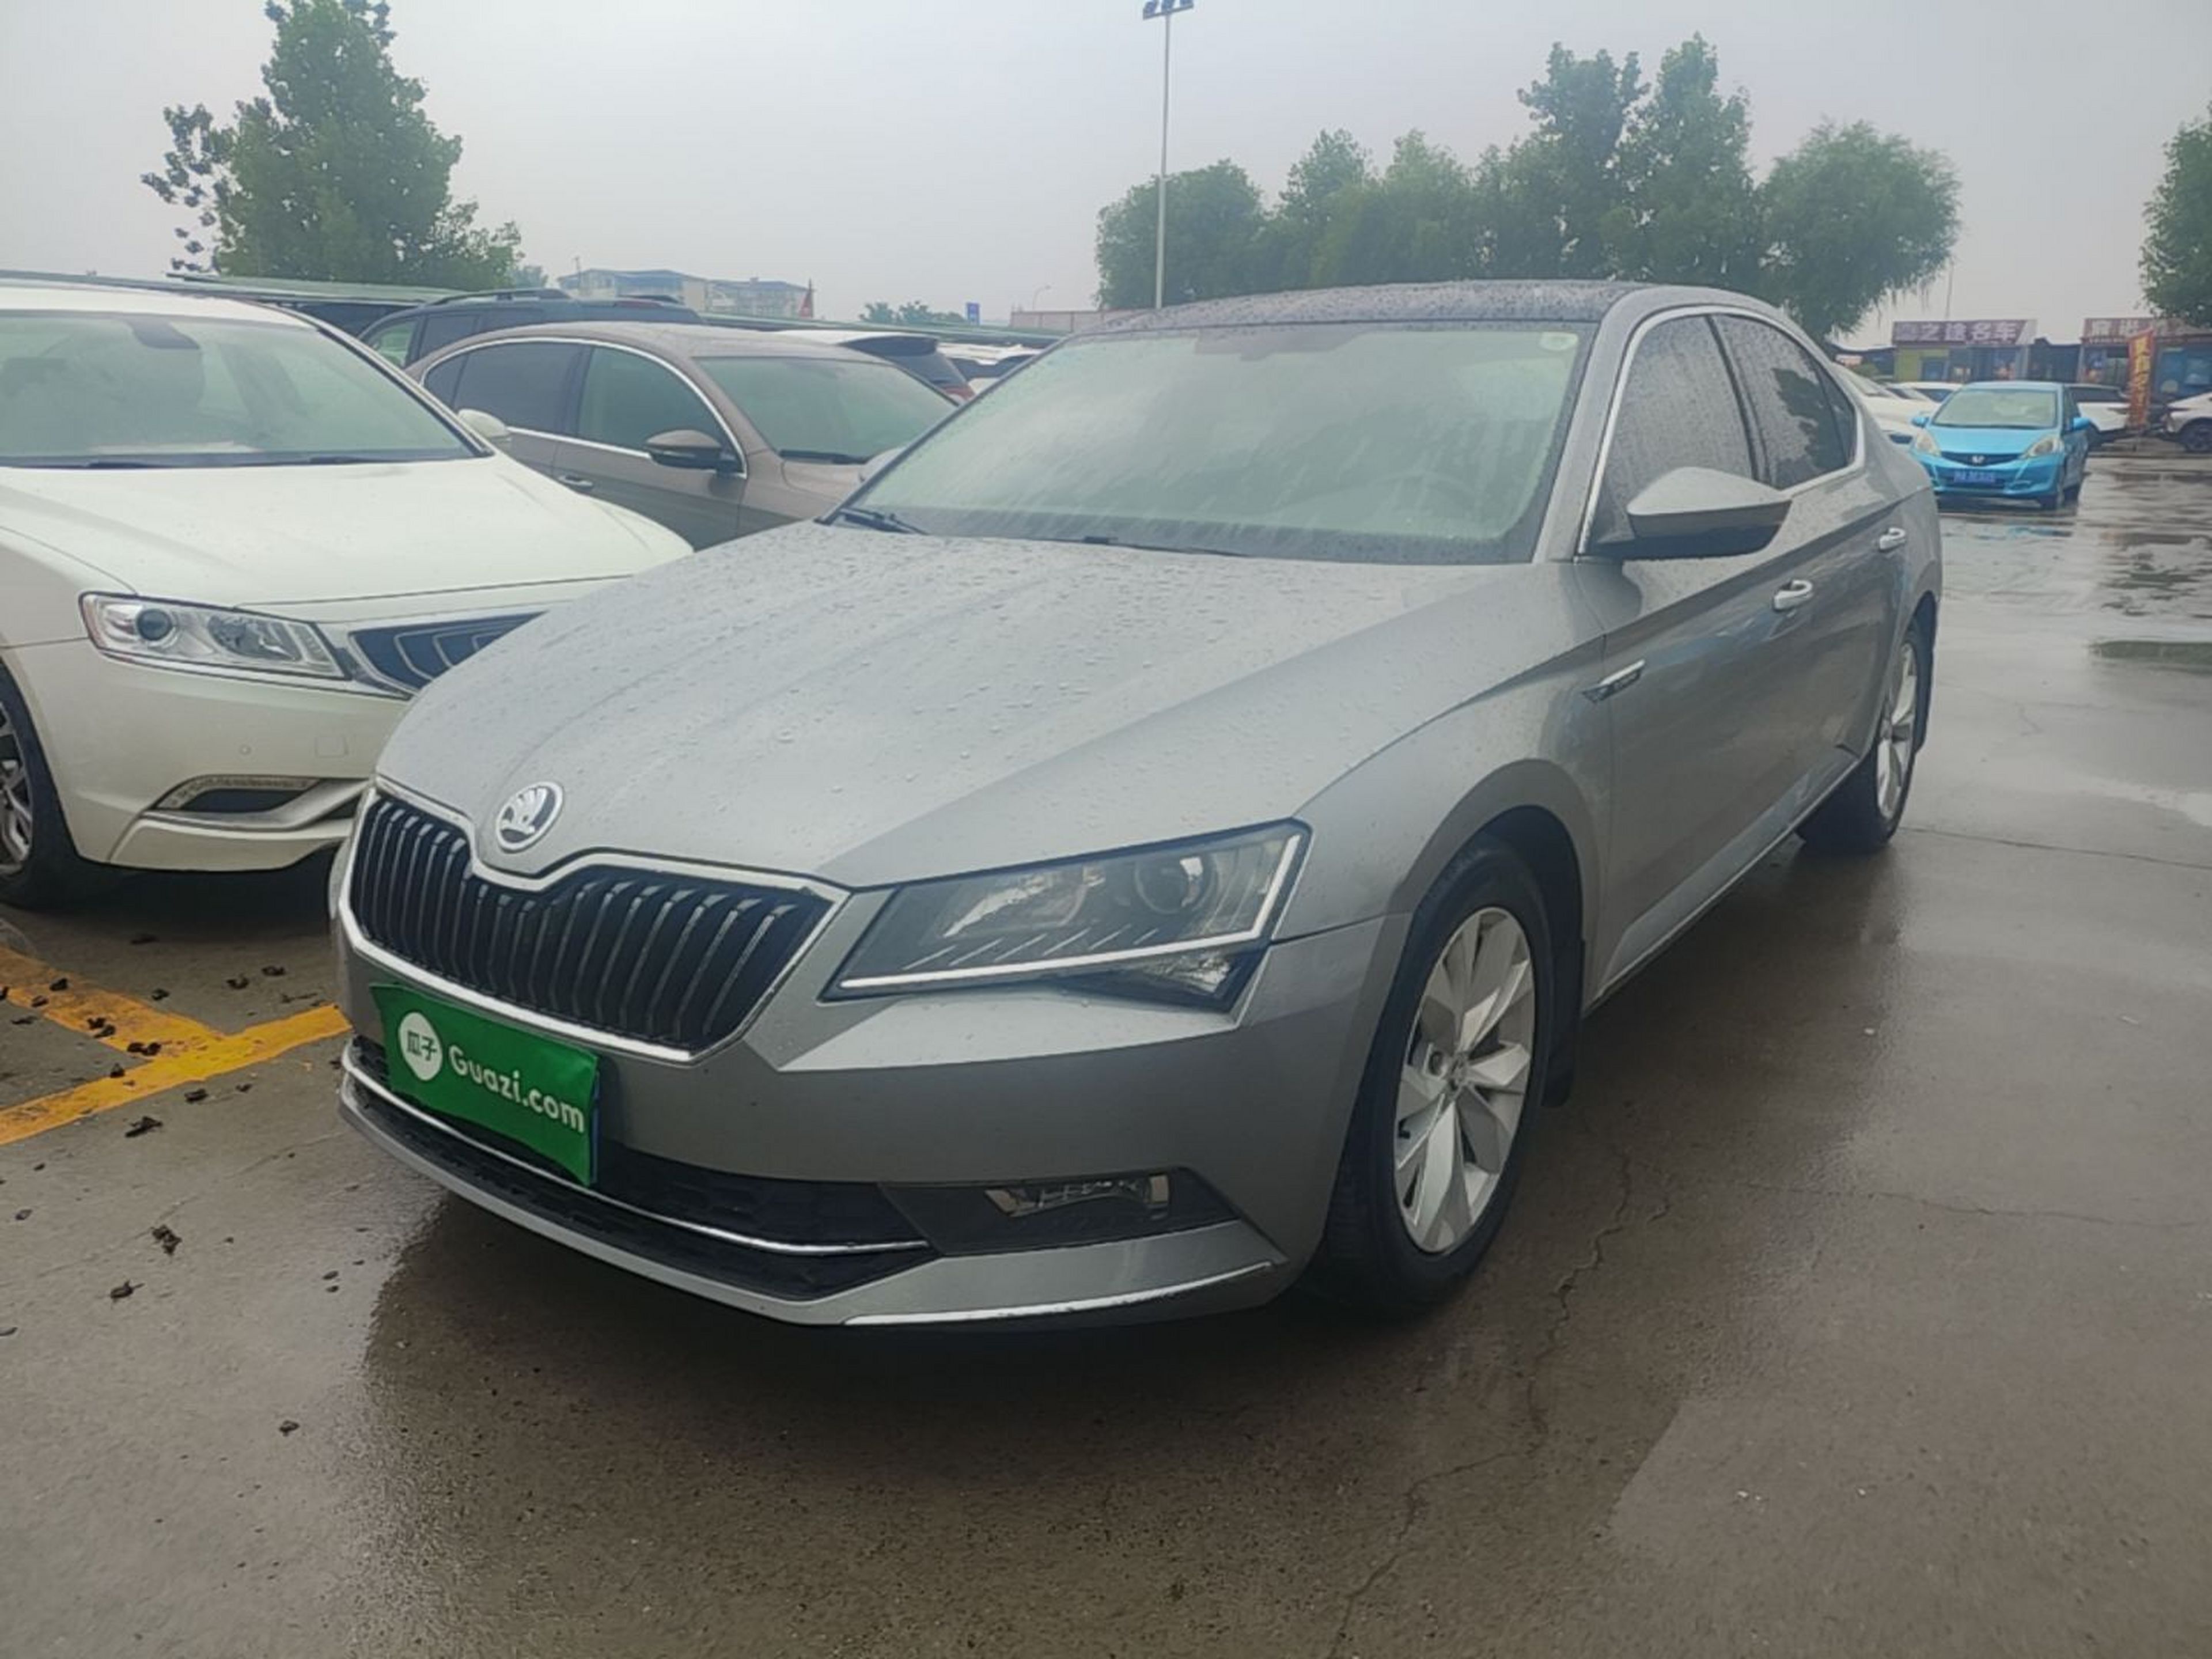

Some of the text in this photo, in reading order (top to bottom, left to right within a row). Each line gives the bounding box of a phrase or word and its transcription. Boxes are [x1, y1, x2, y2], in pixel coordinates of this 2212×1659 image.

[1895, 322, 2016, 341] 之途名车
[406, 1031, 438, 1061] 瓜子
[449, 1045, 585, 1133] Guazi.com
